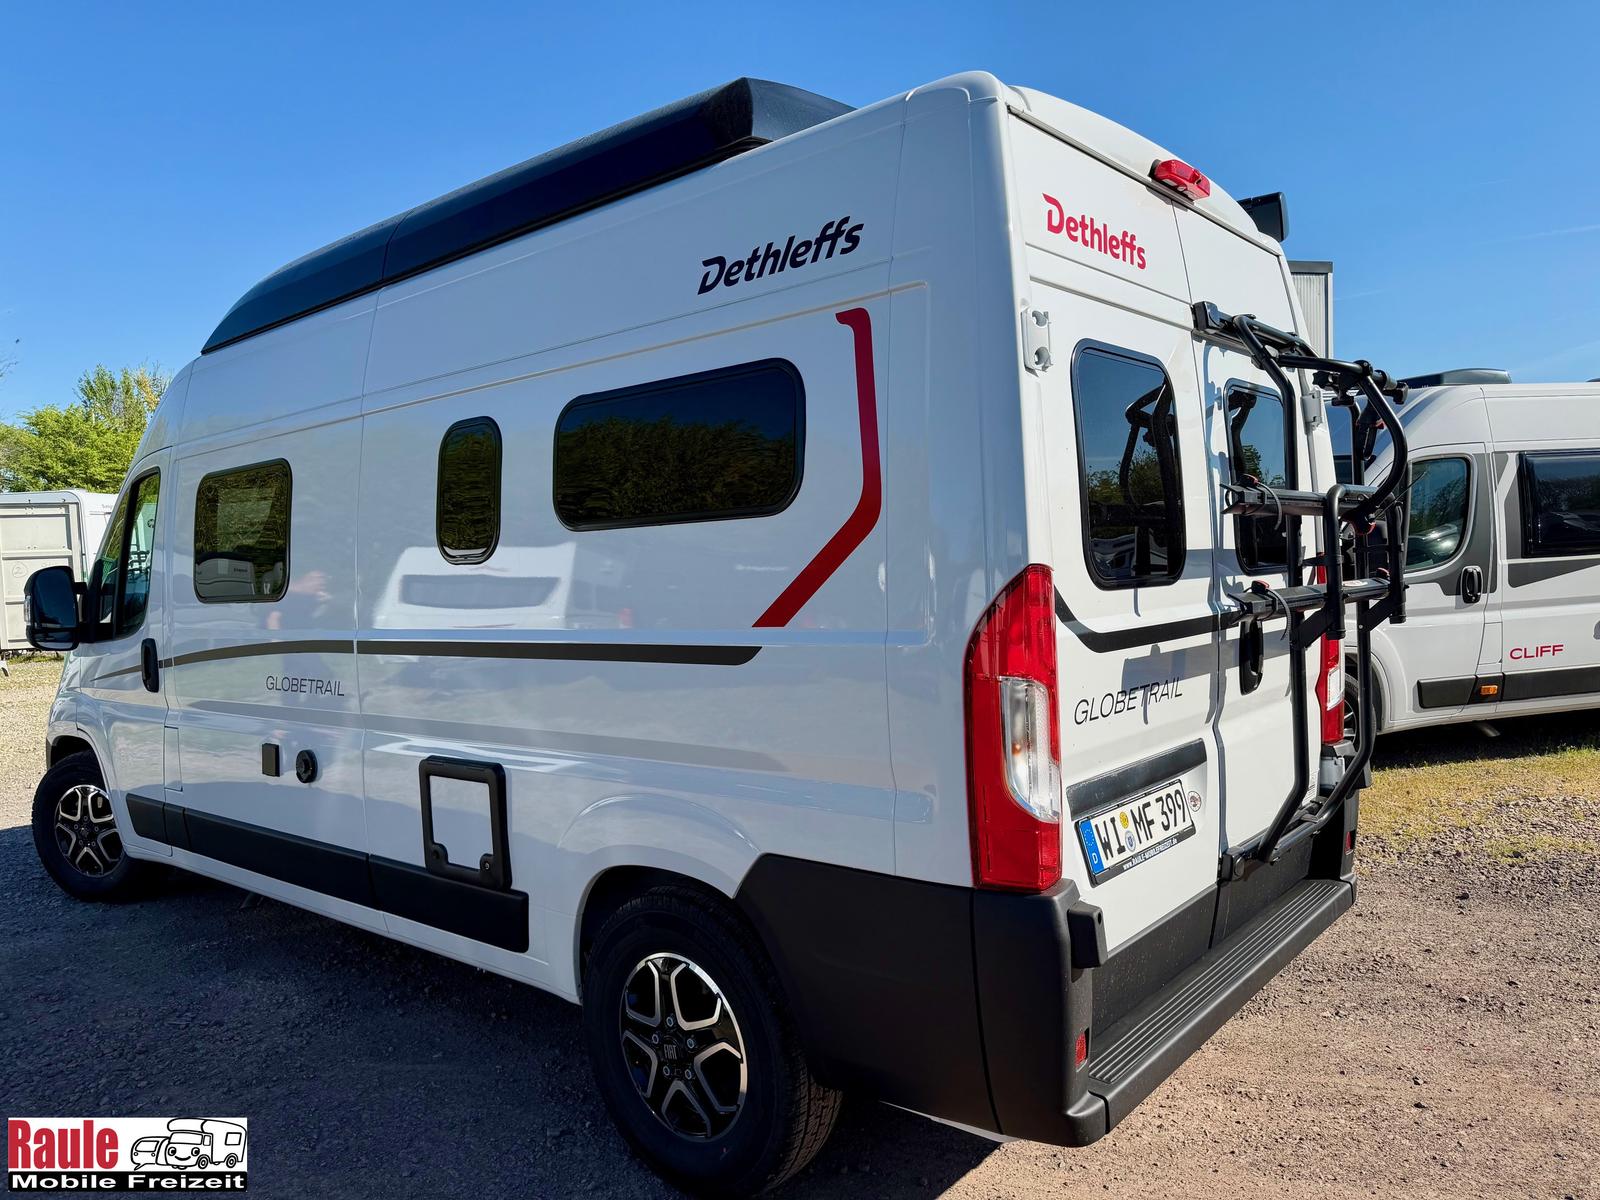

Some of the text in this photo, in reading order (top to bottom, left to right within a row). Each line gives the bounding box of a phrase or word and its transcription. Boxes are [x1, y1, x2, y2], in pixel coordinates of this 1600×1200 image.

[697, 215, 865, 296] Dethleffs
[1042, 193, 1147, 270] Dethleffs
[1509, 644, 1564, 660] CLIFF
[265, 675, 345, 697] GLOBETRAIL
[1073, 676, 1183, 725] GLOBETRAIL
[1094, 816, 1127, 861] WI
[1130, 802, 1156, 844] MF
[1155, 788, 1186, 832] 399
[1092, 852, 1099, 865] D
